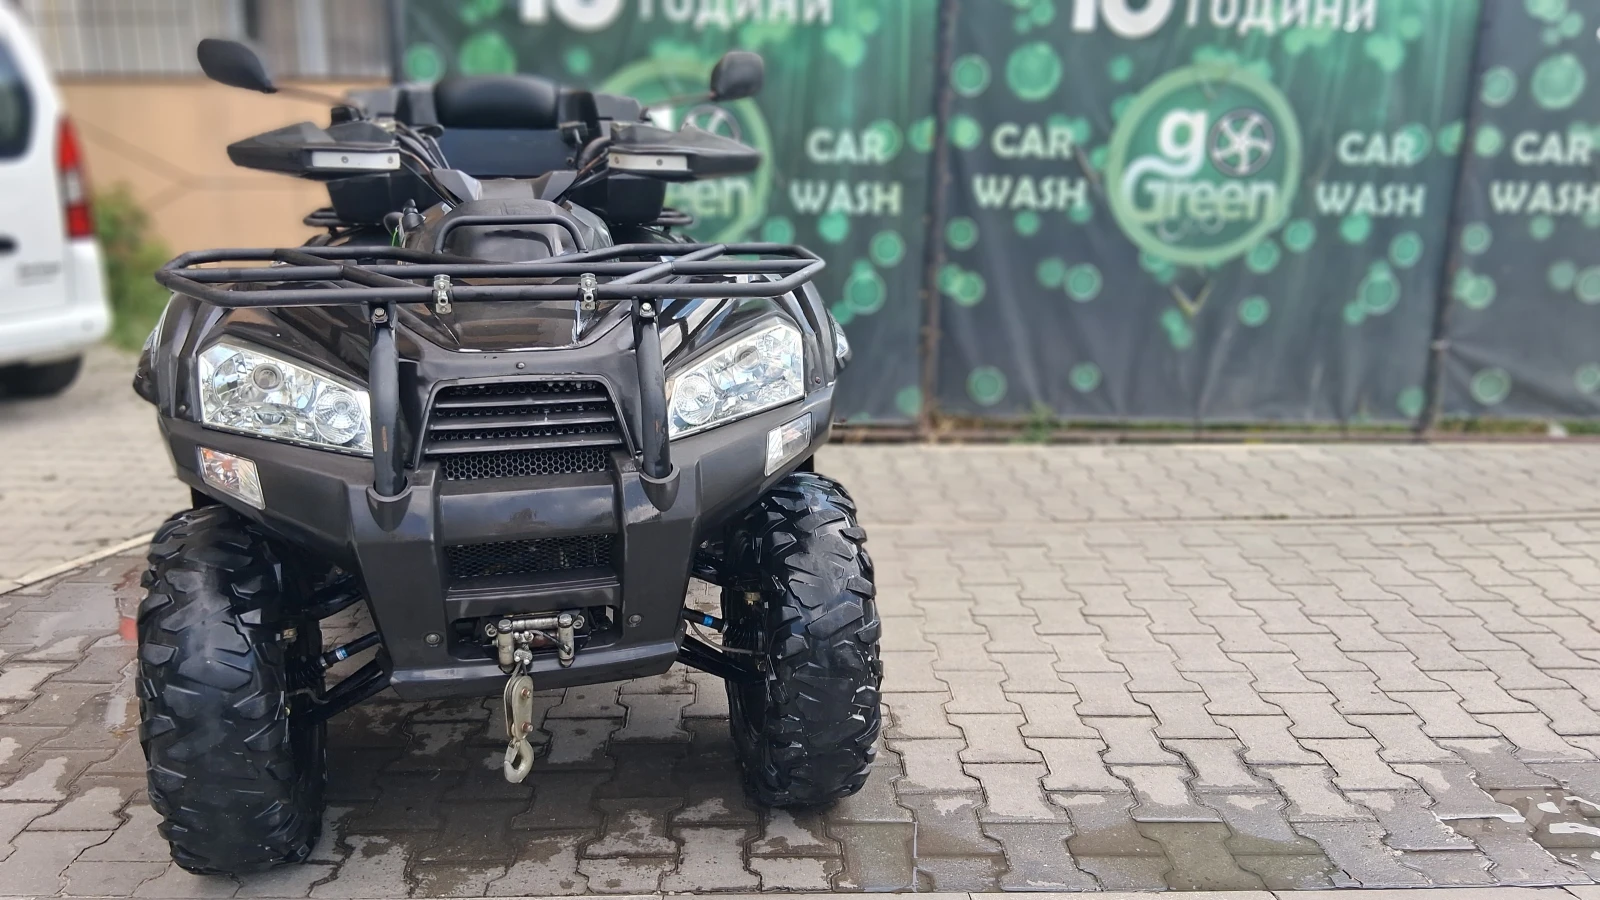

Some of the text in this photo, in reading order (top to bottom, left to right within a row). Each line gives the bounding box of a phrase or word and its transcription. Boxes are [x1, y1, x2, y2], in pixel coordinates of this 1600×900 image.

[806, 126, 887, 163] CAR
[991, 122, 1074, 158] CAR
[1338, 131, 1416, 166] CAR
[1511, 130, 1592, 166] CAR
[789, 180, 902, 216] WASH
[973, 174, 1087, 210] WASH
[1316, 182, 1426, 217] WASH
[1489, 180, 1600, 216] WASH
